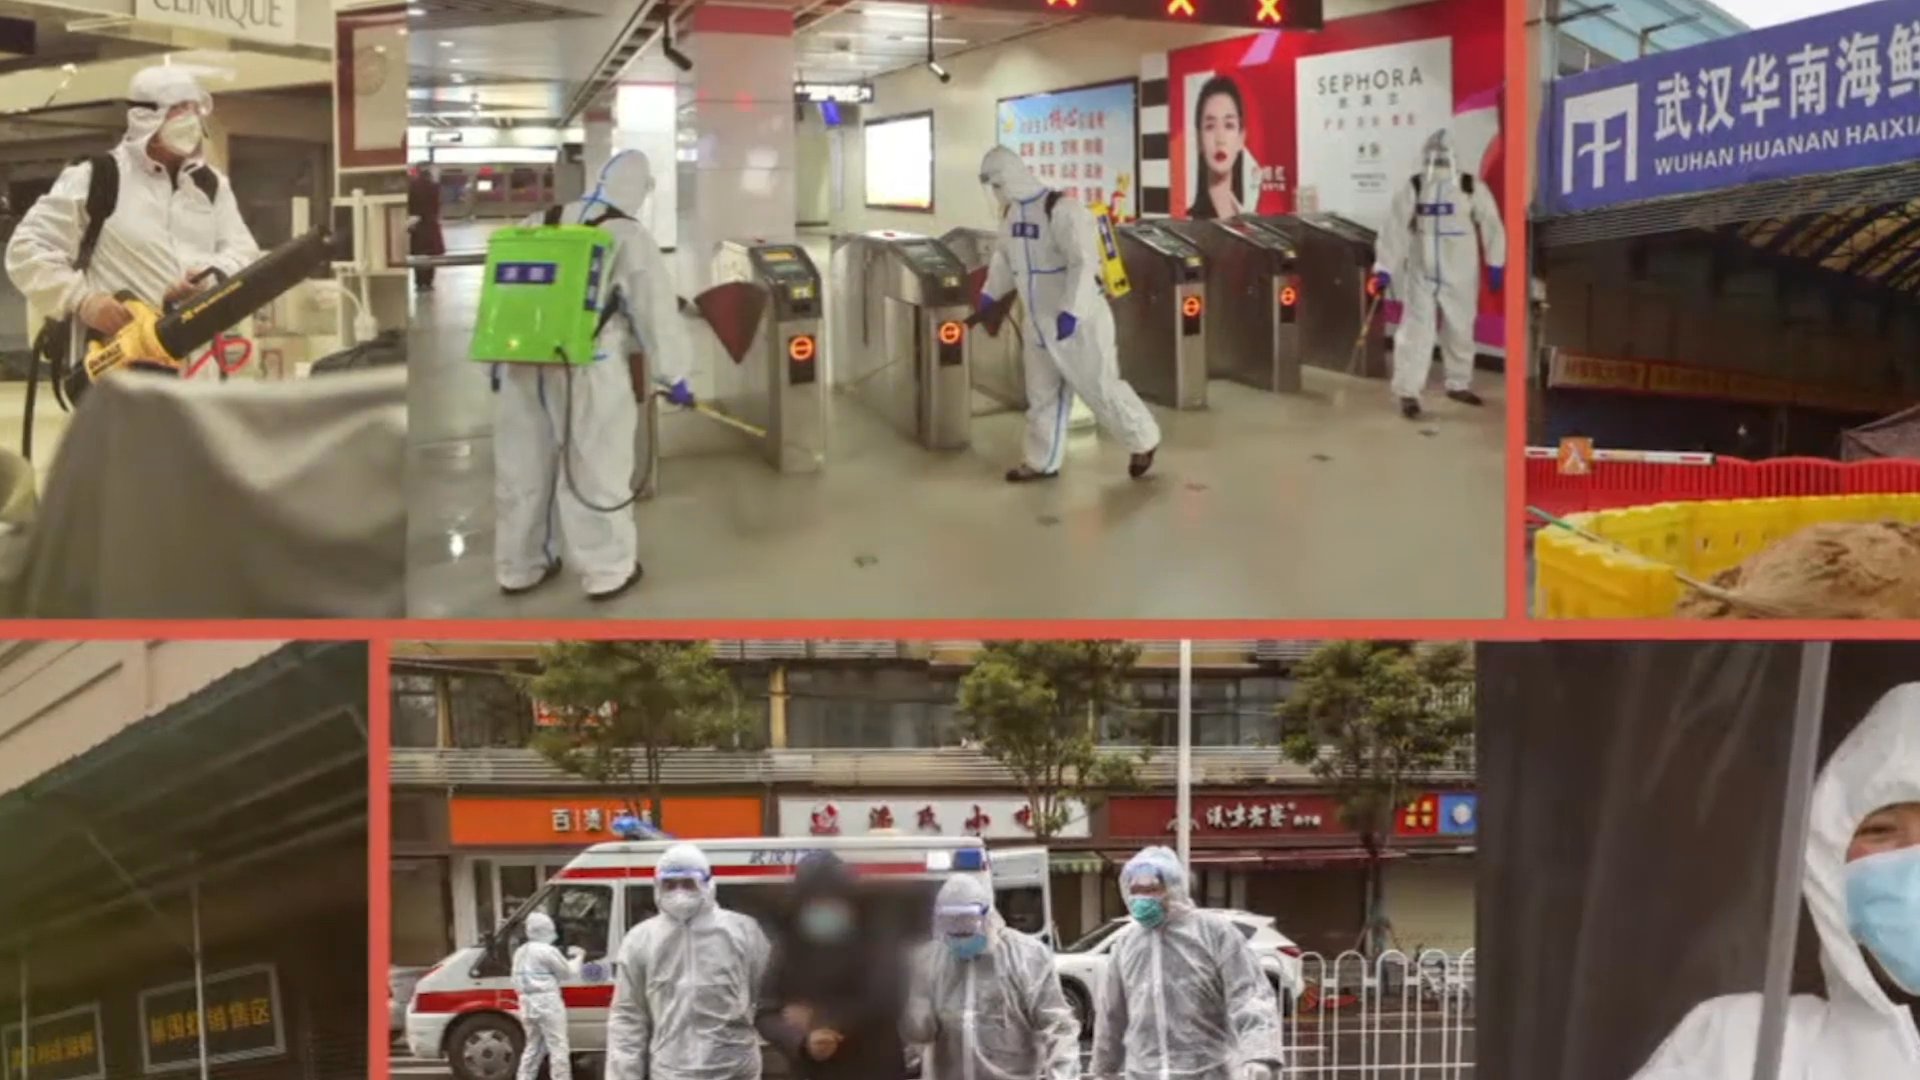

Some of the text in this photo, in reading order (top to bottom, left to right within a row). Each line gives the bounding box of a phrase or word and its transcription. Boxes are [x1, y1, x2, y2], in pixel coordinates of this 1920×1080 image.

[1317, 66, 1423, 95] SEPHORA
[1654, 21, 1920, 142] 武汉华南海鲜
[1654, 147, 1734, 176] WUHAN
[1739, 129, 1839, 163] HUANAN
